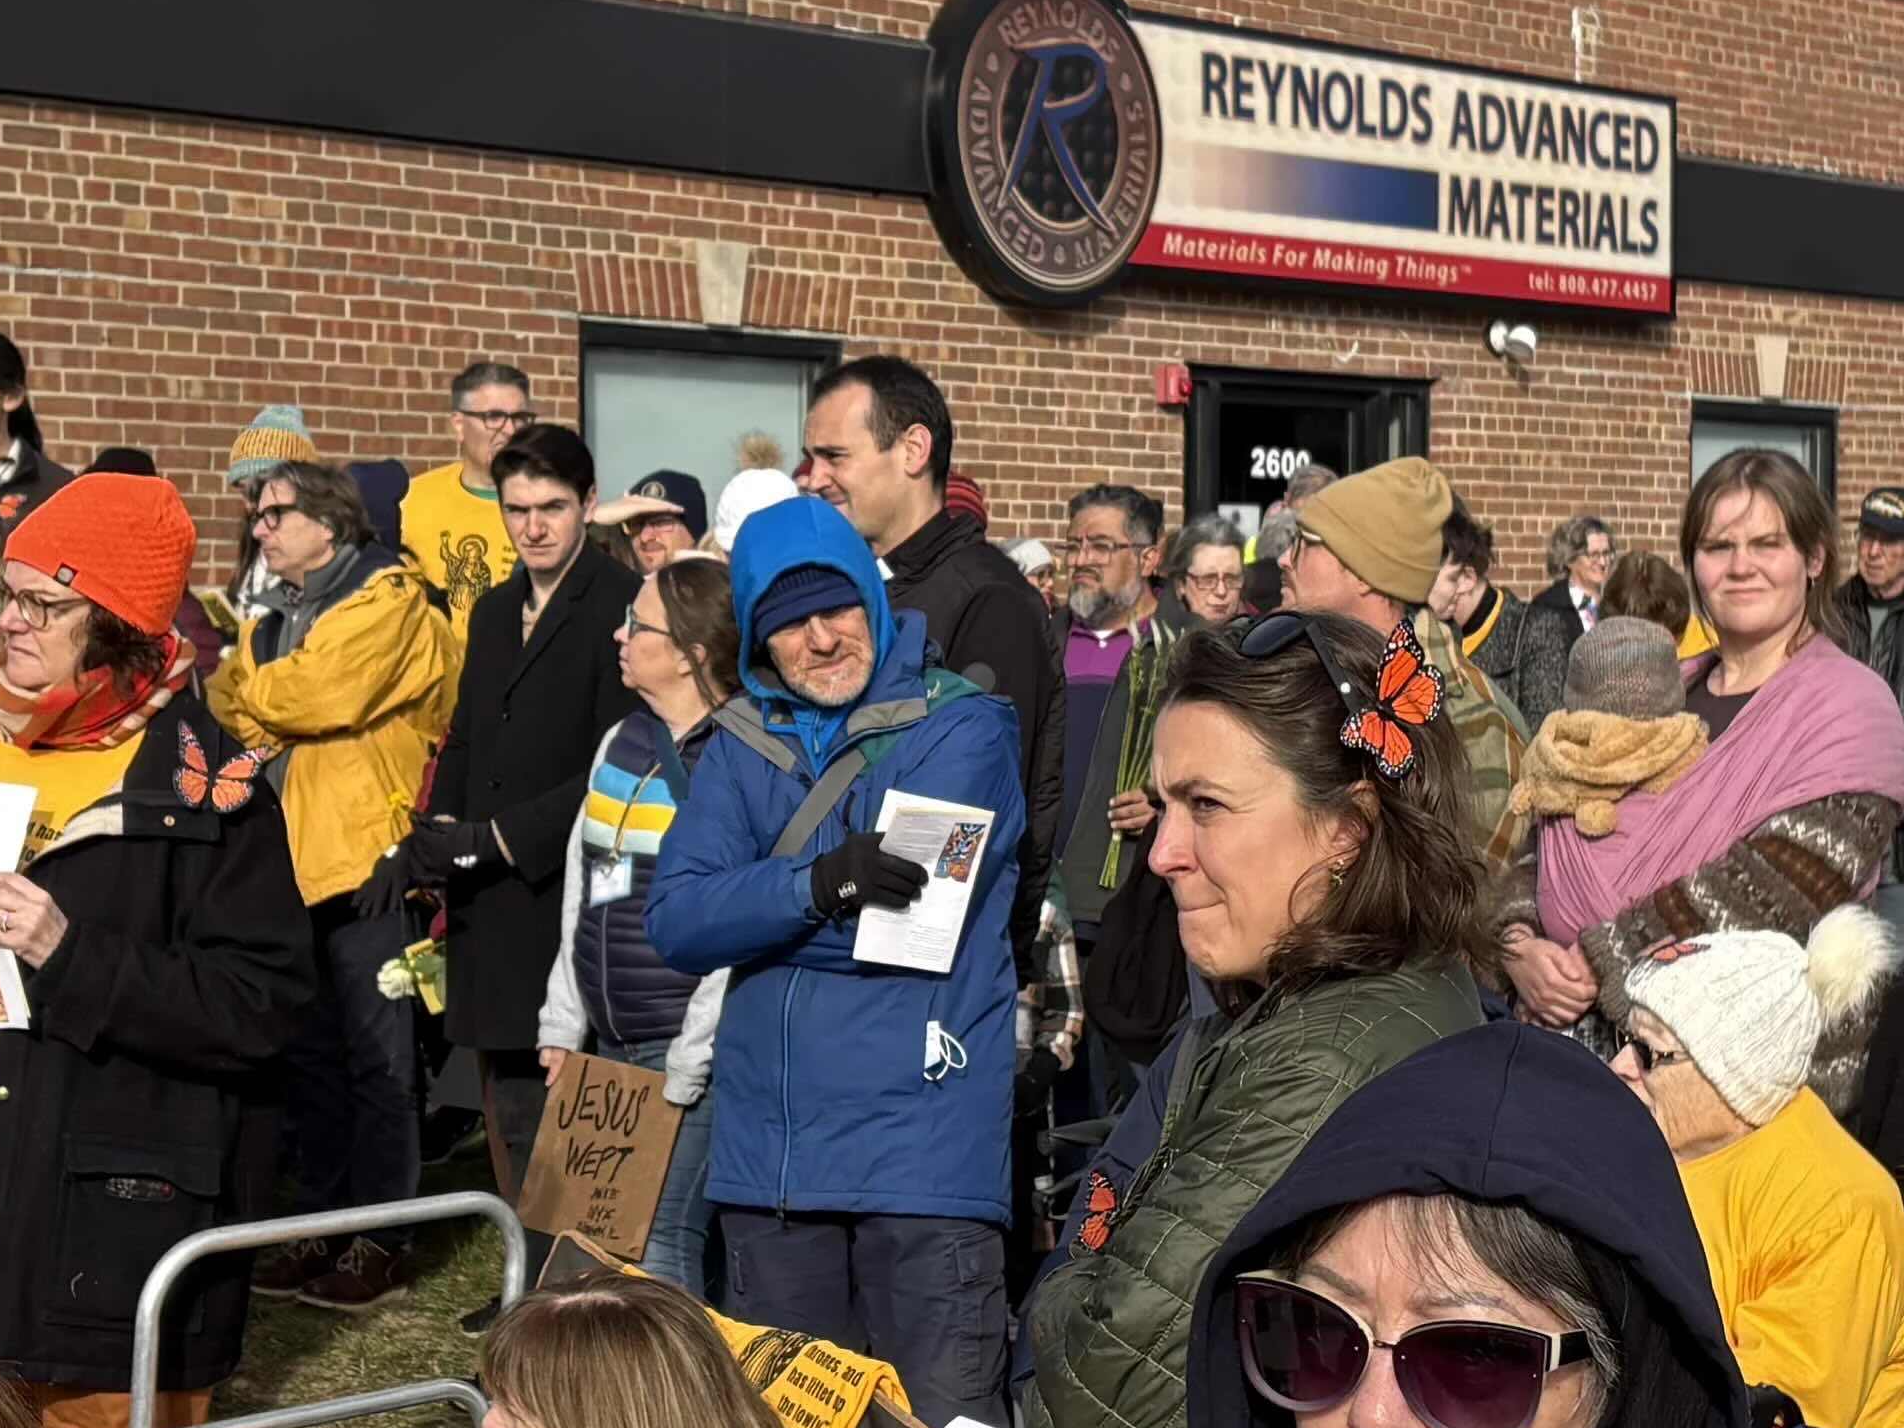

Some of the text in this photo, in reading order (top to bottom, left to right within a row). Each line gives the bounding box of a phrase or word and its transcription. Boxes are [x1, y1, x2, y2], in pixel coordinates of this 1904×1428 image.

[1201, 50, 1660, 175] REYNOLDS ADVANCED
[968, 76, 1045, 264] ADVANCED
[1074, 99, 1147, 270] MATERIALS
[1447, 172, 1660, 257] MATERIALS
[1162, 232, 1267, 264] Materials
[1272, 243, 1308, 269] For
[1312, 246, 1389, 281] Making
[1528, 271, 1555, 293] tel:
[1249, 446, 1311, 480] 2600
[558, 1058, 650, 1138] JESUS
[564, 1135, 636, 1184] WEPT
[776, 1392, 797, 1418] the
[786, 1365, 810, 1390] has
[805, 1375, 836, 1407] lifted
